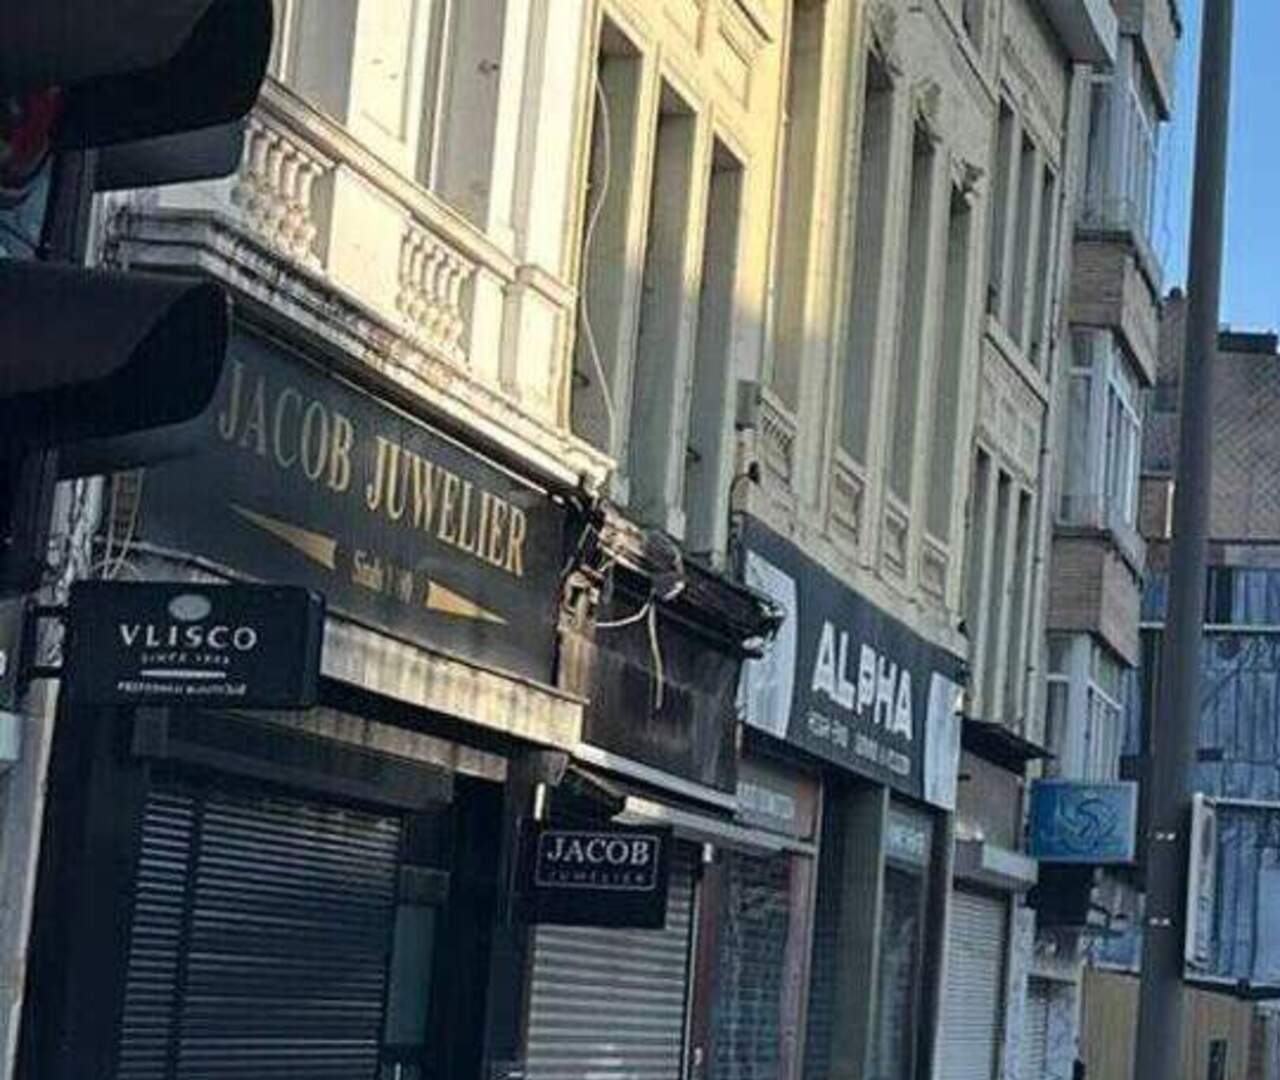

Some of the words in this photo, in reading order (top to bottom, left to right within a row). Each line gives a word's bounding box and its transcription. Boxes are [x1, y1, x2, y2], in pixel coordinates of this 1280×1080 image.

[218, 359, 354, 492] JACOB
[366, 434, 527, 577] JUWELIER
[119, 623, 258, 651] VLISCO
[811, 619, 913, 741] ALPHA
[546, 837, 650, 866] JACOB
